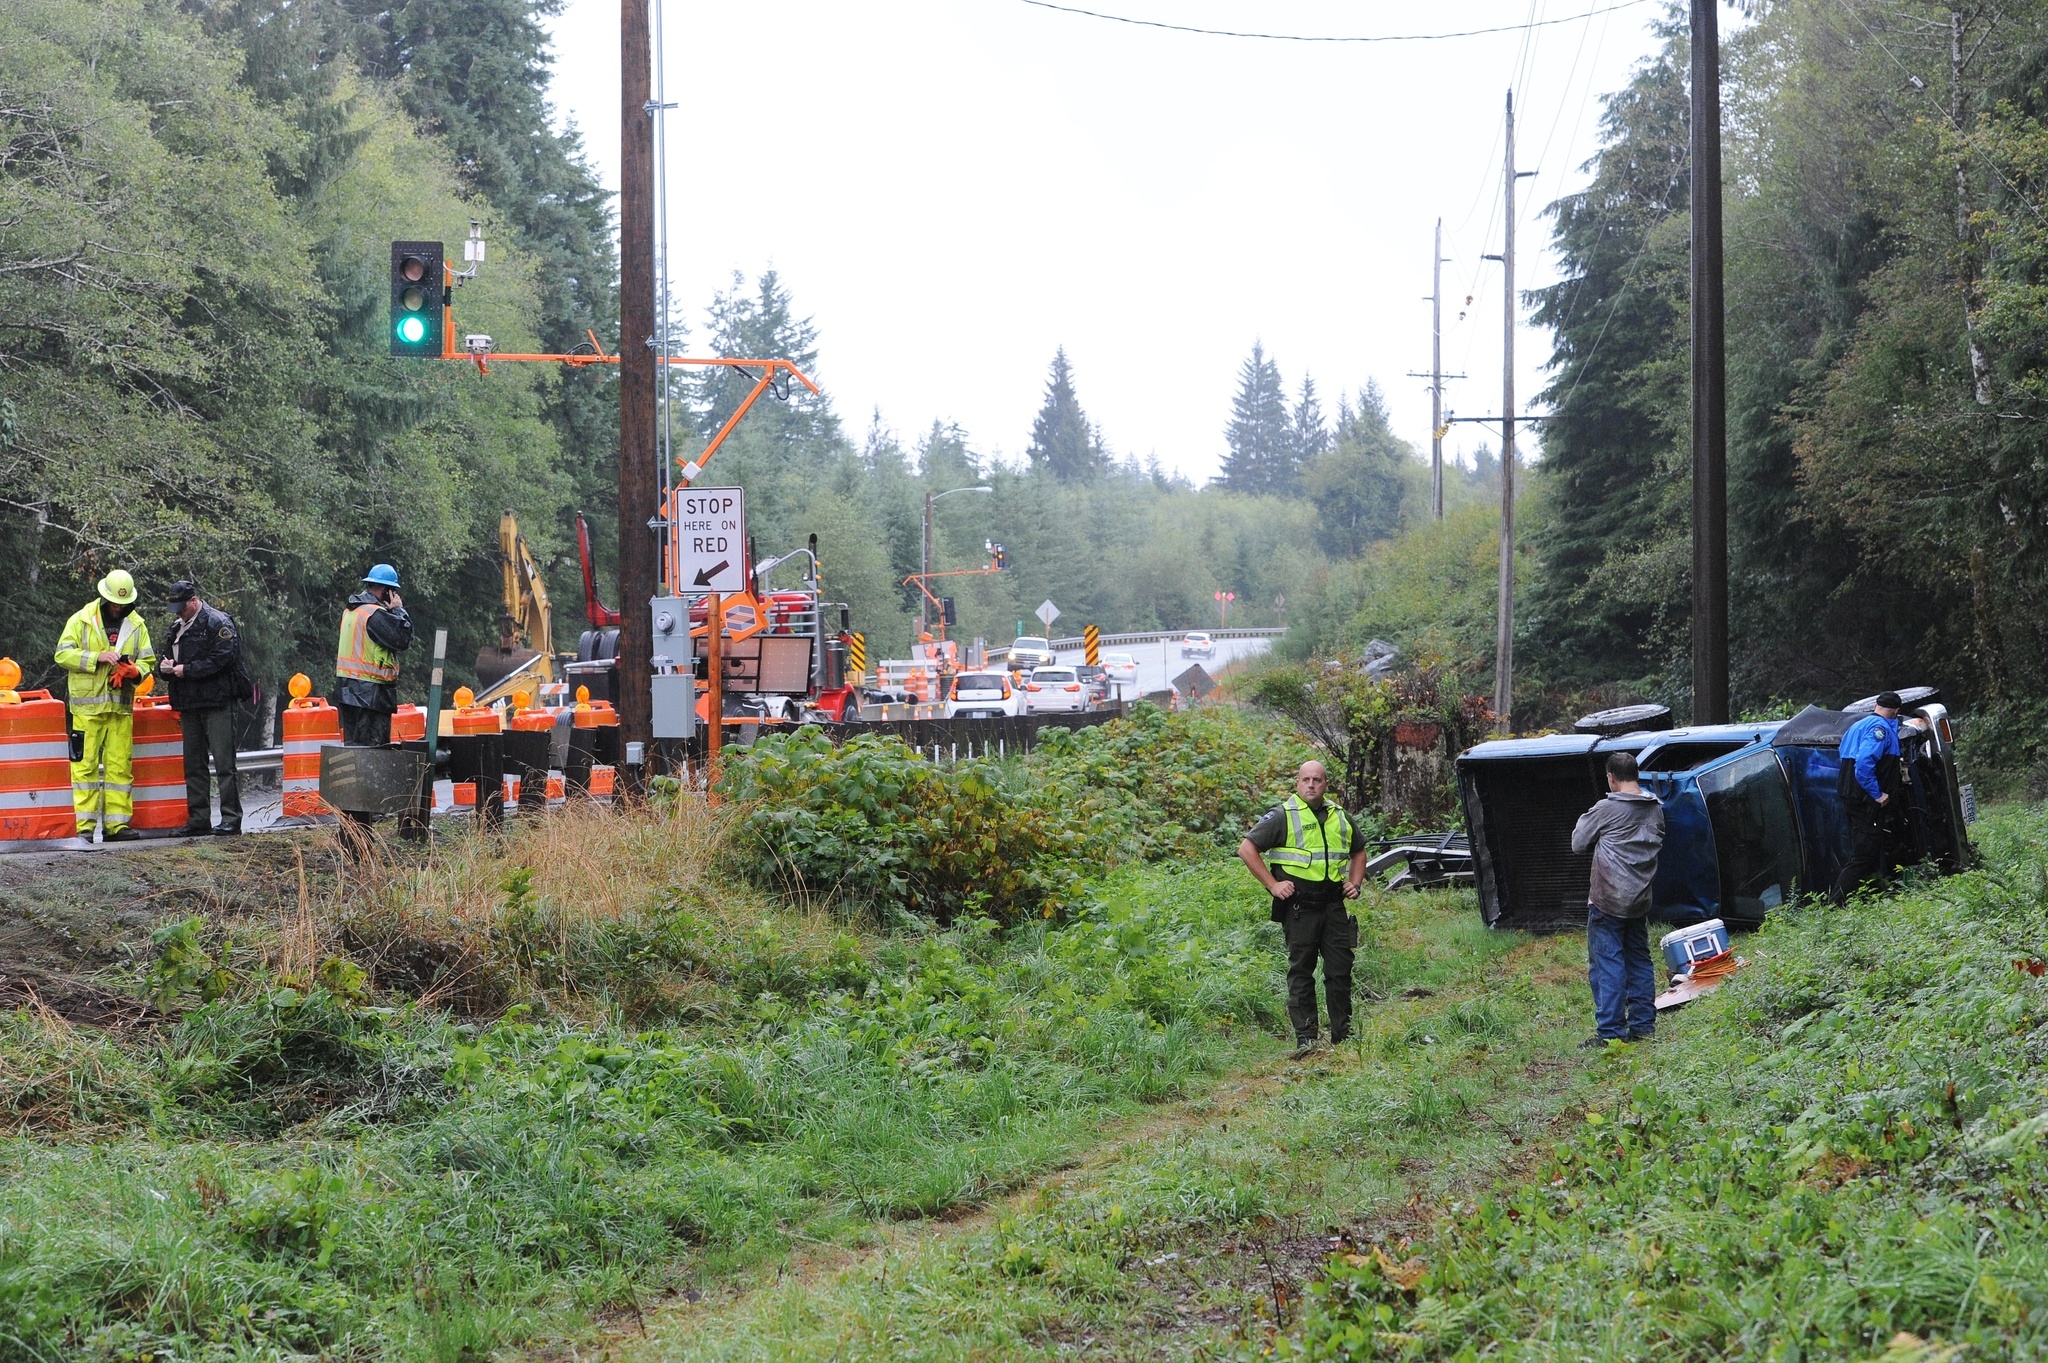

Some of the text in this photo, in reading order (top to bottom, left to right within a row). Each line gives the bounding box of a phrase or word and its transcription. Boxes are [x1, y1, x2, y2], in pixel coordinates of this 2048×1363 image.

[686, 498, 733, 515] STOP
[684, 520, 736, 531] HERE ON
[693, 537, 728, 553] RED
